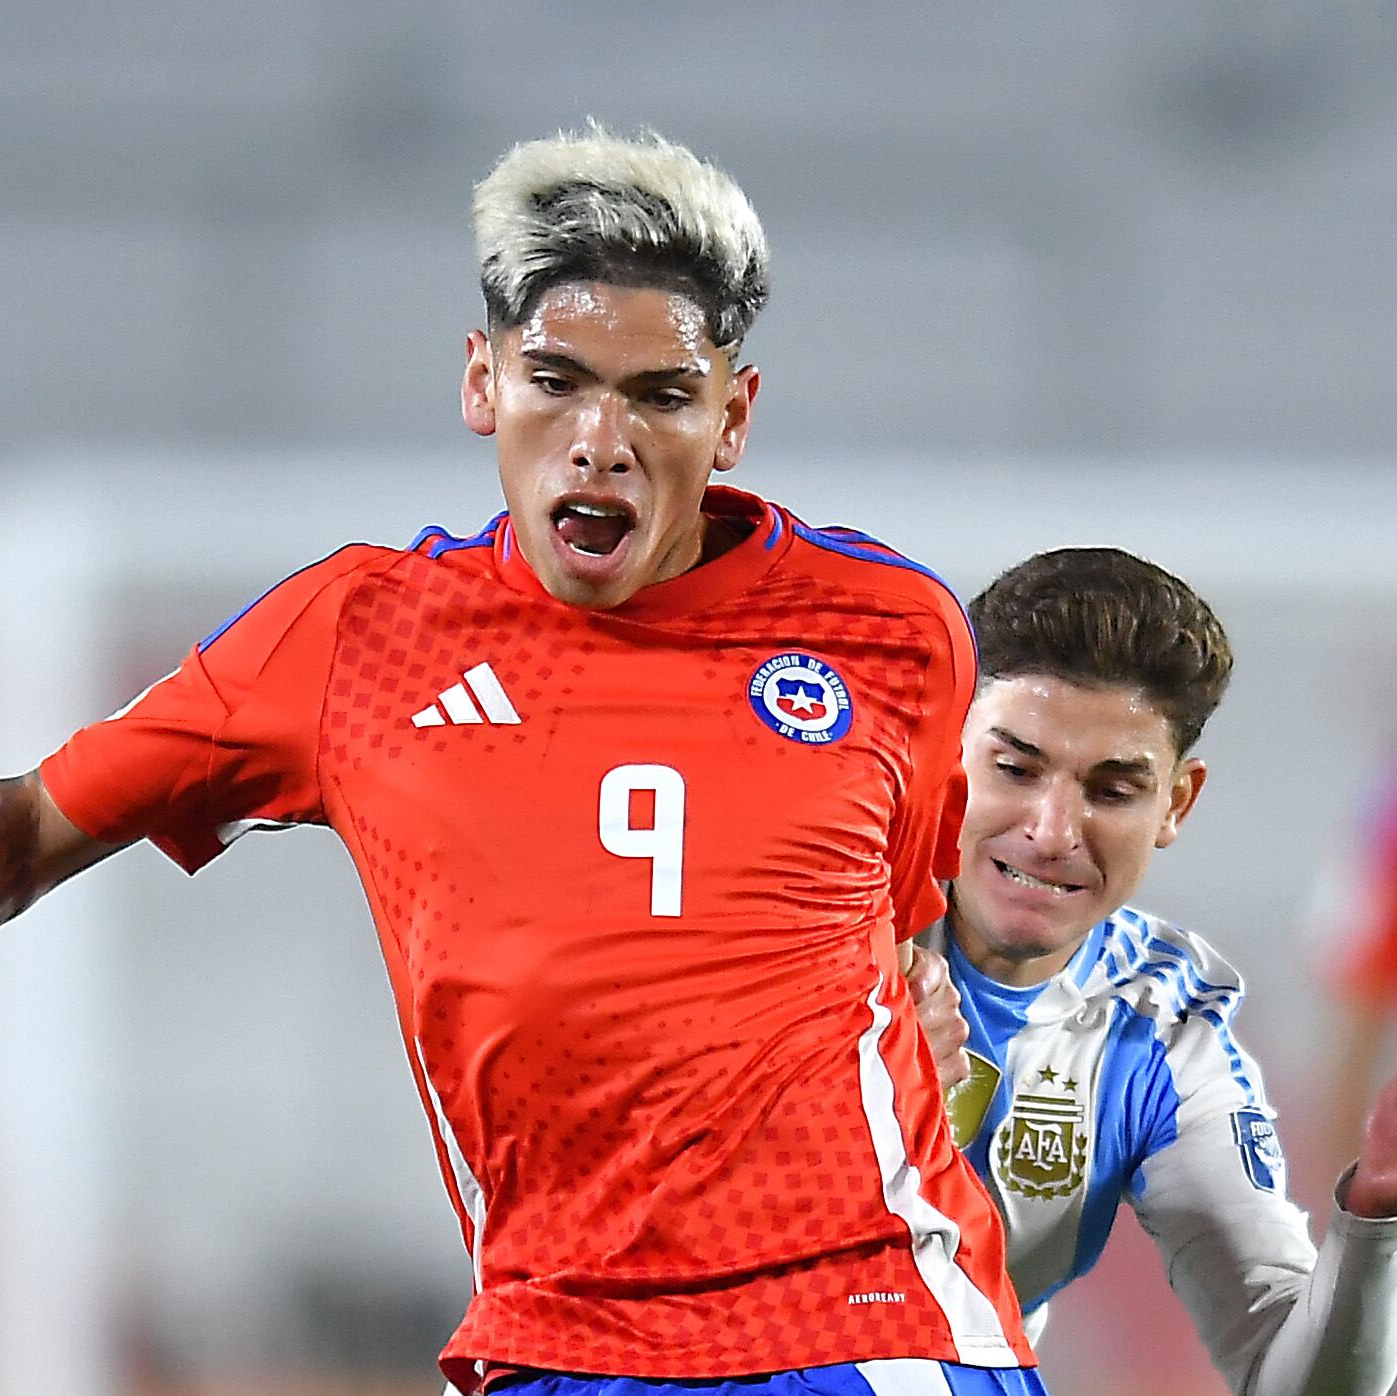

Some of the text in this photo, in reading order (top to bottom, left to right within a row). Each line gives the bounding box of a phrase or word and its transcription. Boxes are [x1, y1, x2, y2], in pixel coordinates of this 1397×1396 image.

[750, 655, 800, 697] FEDERACION
[807, 658, 823, 673] DE
[779, 724, 832, 742] DE CHILE
[599, 763, 686, 917] 9
[1015, 1121, 1068, 1171] AFA
